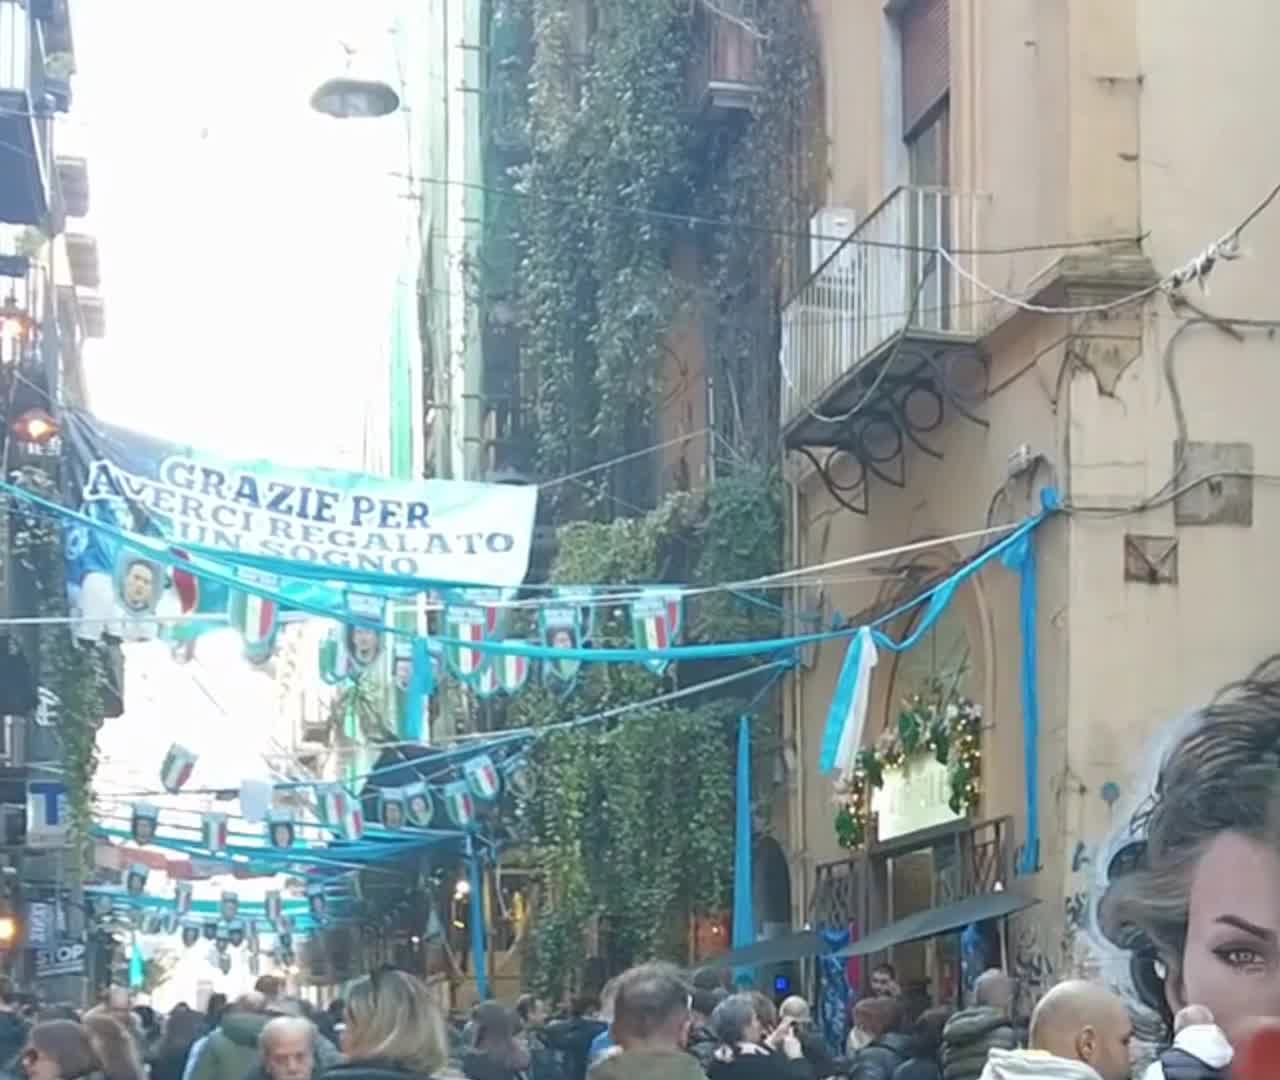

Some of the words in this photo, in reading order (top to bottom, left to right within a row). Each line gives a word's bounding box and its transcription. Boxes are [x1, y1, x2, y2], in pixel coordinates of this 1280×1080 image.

[87, 461, 255, 533] AVERCI
[269, 516, 515, 555] REGALATO
[165, 459, 340, 524] GRAZIE
[351, 495, 430, 530] PER
[179, 521, 243, 549] UN
[258, 538, 420, 577] SOGNO
